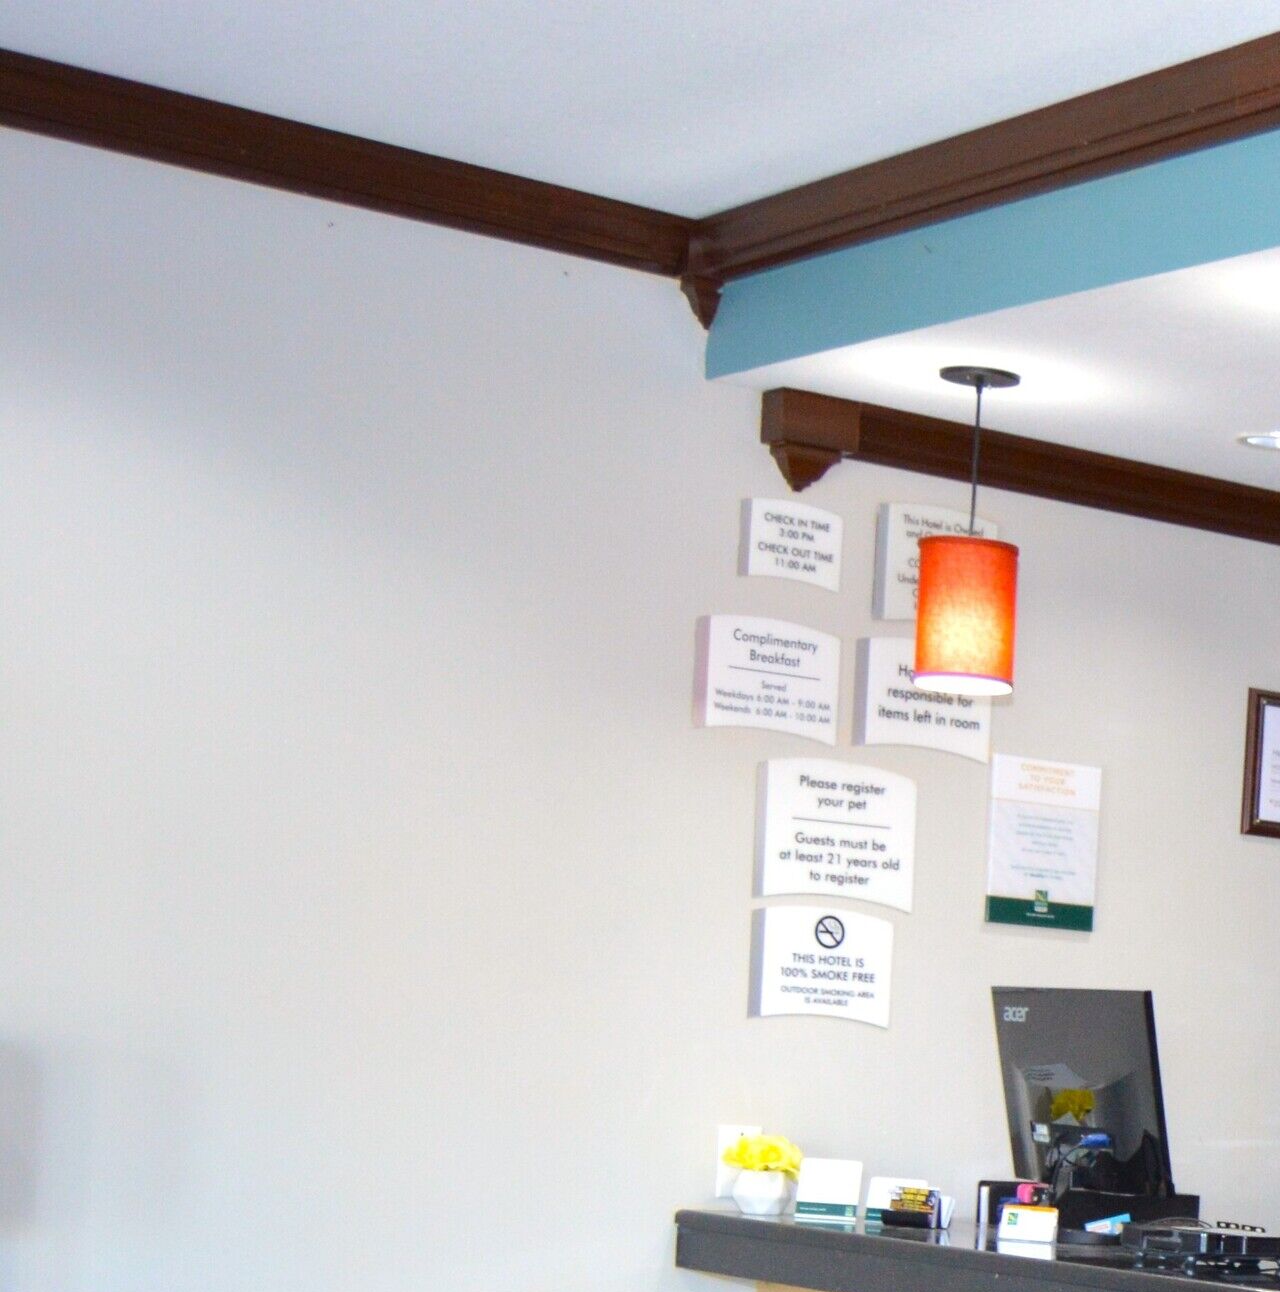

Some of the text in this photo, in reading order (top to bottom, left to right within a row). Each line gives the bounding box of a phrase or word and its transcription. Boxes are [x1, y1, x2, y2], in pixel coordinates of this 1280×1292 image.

[764, 512, 831, 533] CHECK IN TIME
[904, 513, 920, 525] This
[921, 518, 943, 530] Hotel
[801, 532, 815, 543] PM
[758, 541, 834, 563] CHECK OUT TIME
[802, 563, 817, 572] AM
[733, 628, 818, 655] Complimentary
[749, 649, 801, 668] Breakfast
[761, 680, 787, 692] Served
[714, 687, 754, 702] Weekdays
[777, 697, 790, 705] AM
[818, 703, 831, 711] AM
[887, 687, 974, 708] responsible for
[774, 710, 788, 719] AM
[818, 715, 831, 724] AM
[878, 705, 981, 731] items left in room
[799, 774, 886, 796] Please register
[817, 797, 867, 812] your pet
[794, 831, 887, 852] Guests must be
[779, 849, 900, 871] at least 21 years old
[809, 869, 870, 886] to register
[792, 952, 865, 968] THIS HOTEL IS
[780, 966, 876, 983] 100% SMOKE FREE
[780, 985, 875, 999] OUTDOOR SMOKING AREA
[812, 997, 848, 1006] AVAILABLE
[1003, 1006, 1029, 1022] acer
